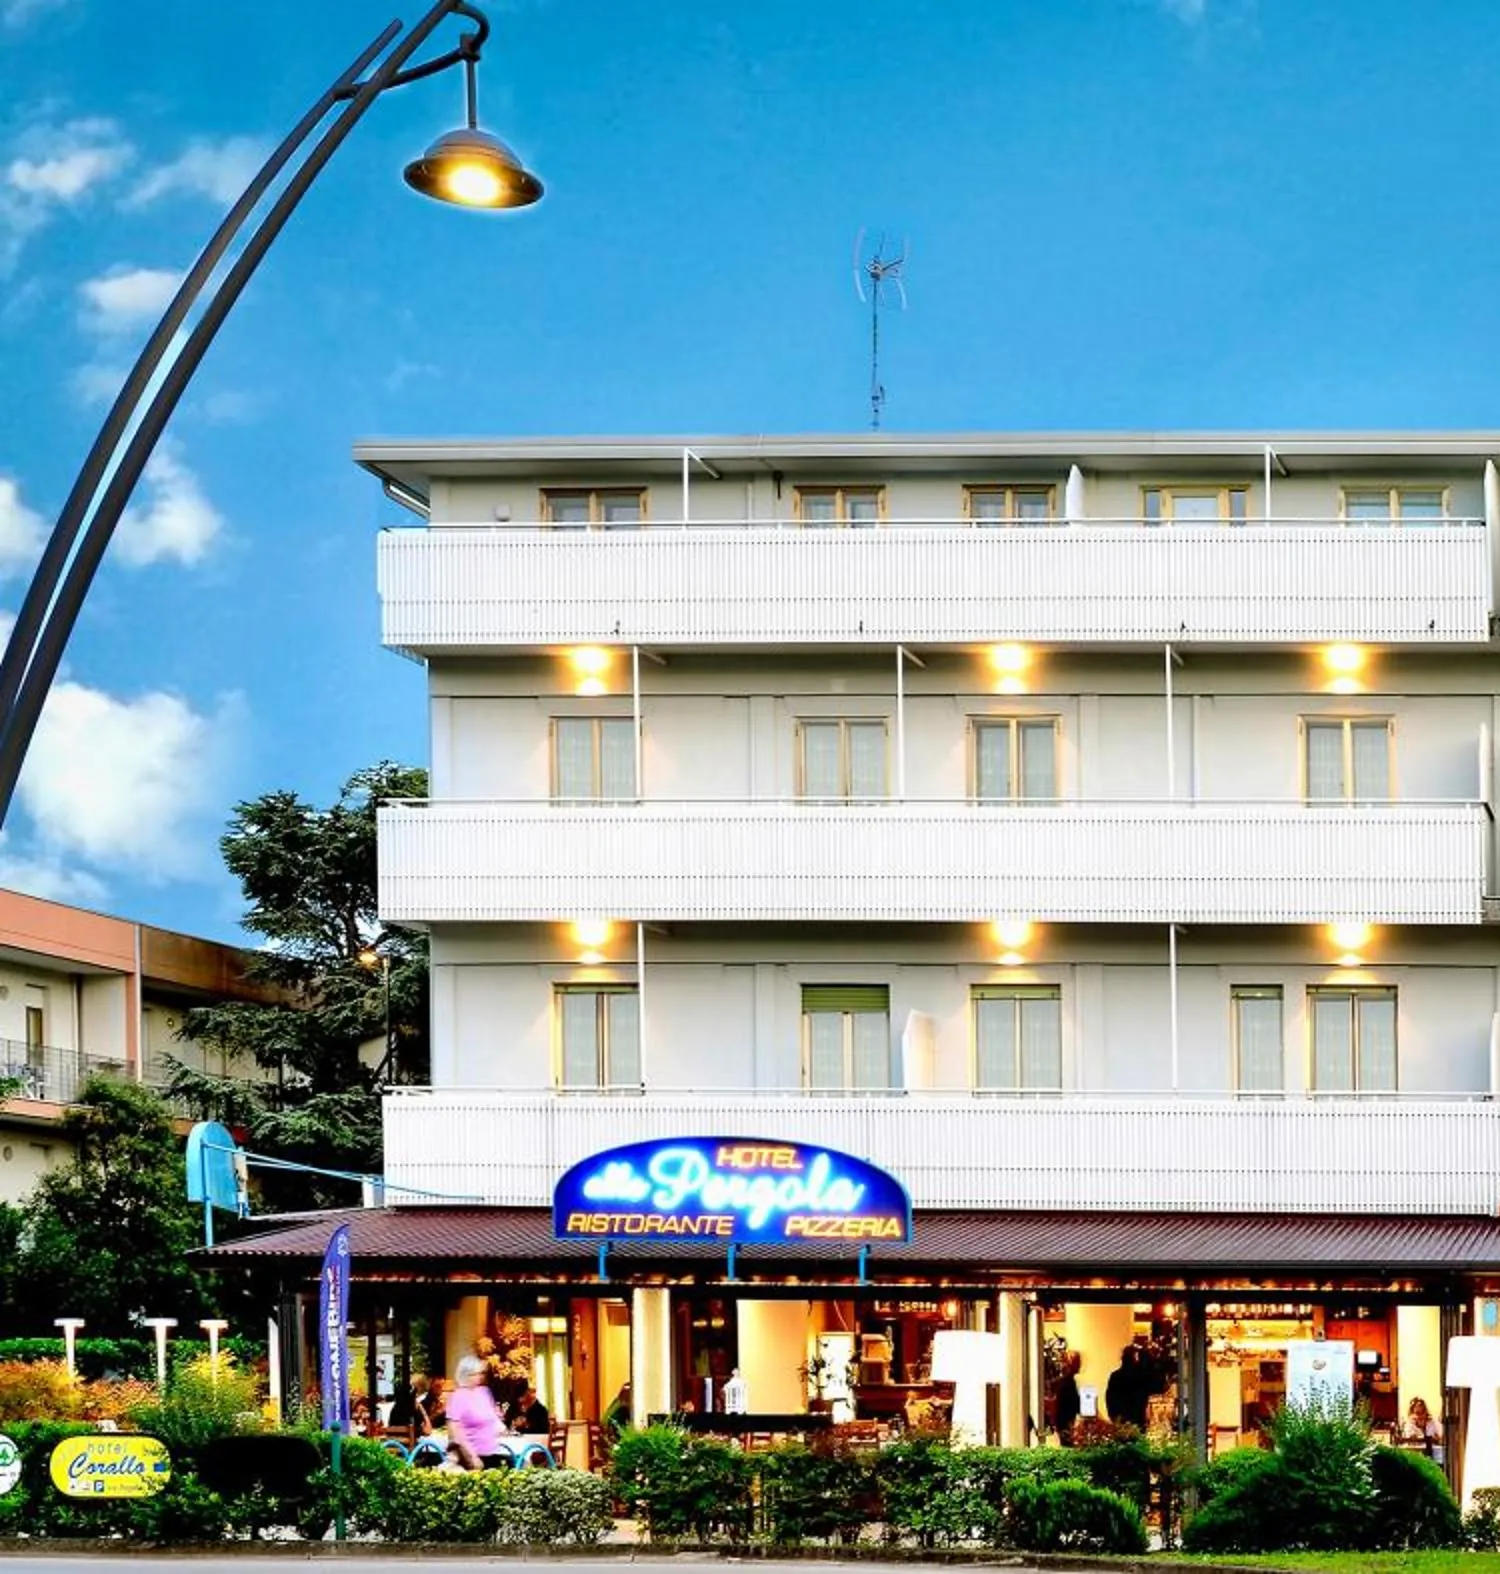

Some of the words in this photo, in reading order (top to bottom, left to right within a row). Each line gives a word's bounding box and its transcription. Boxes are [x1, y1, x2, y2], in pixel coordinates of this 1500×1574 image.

[716, 1147, 803, 1169] HOTEL
[647, 1149, 866, 1230] Pergola
[566, 1212, 735, 1236] RISTORANTE
[784, 1216, 902, 1239] PIZZERIA
[87, 1442, 128, 1455] hotel
[68, 1451, 145, 1479] Corallo
